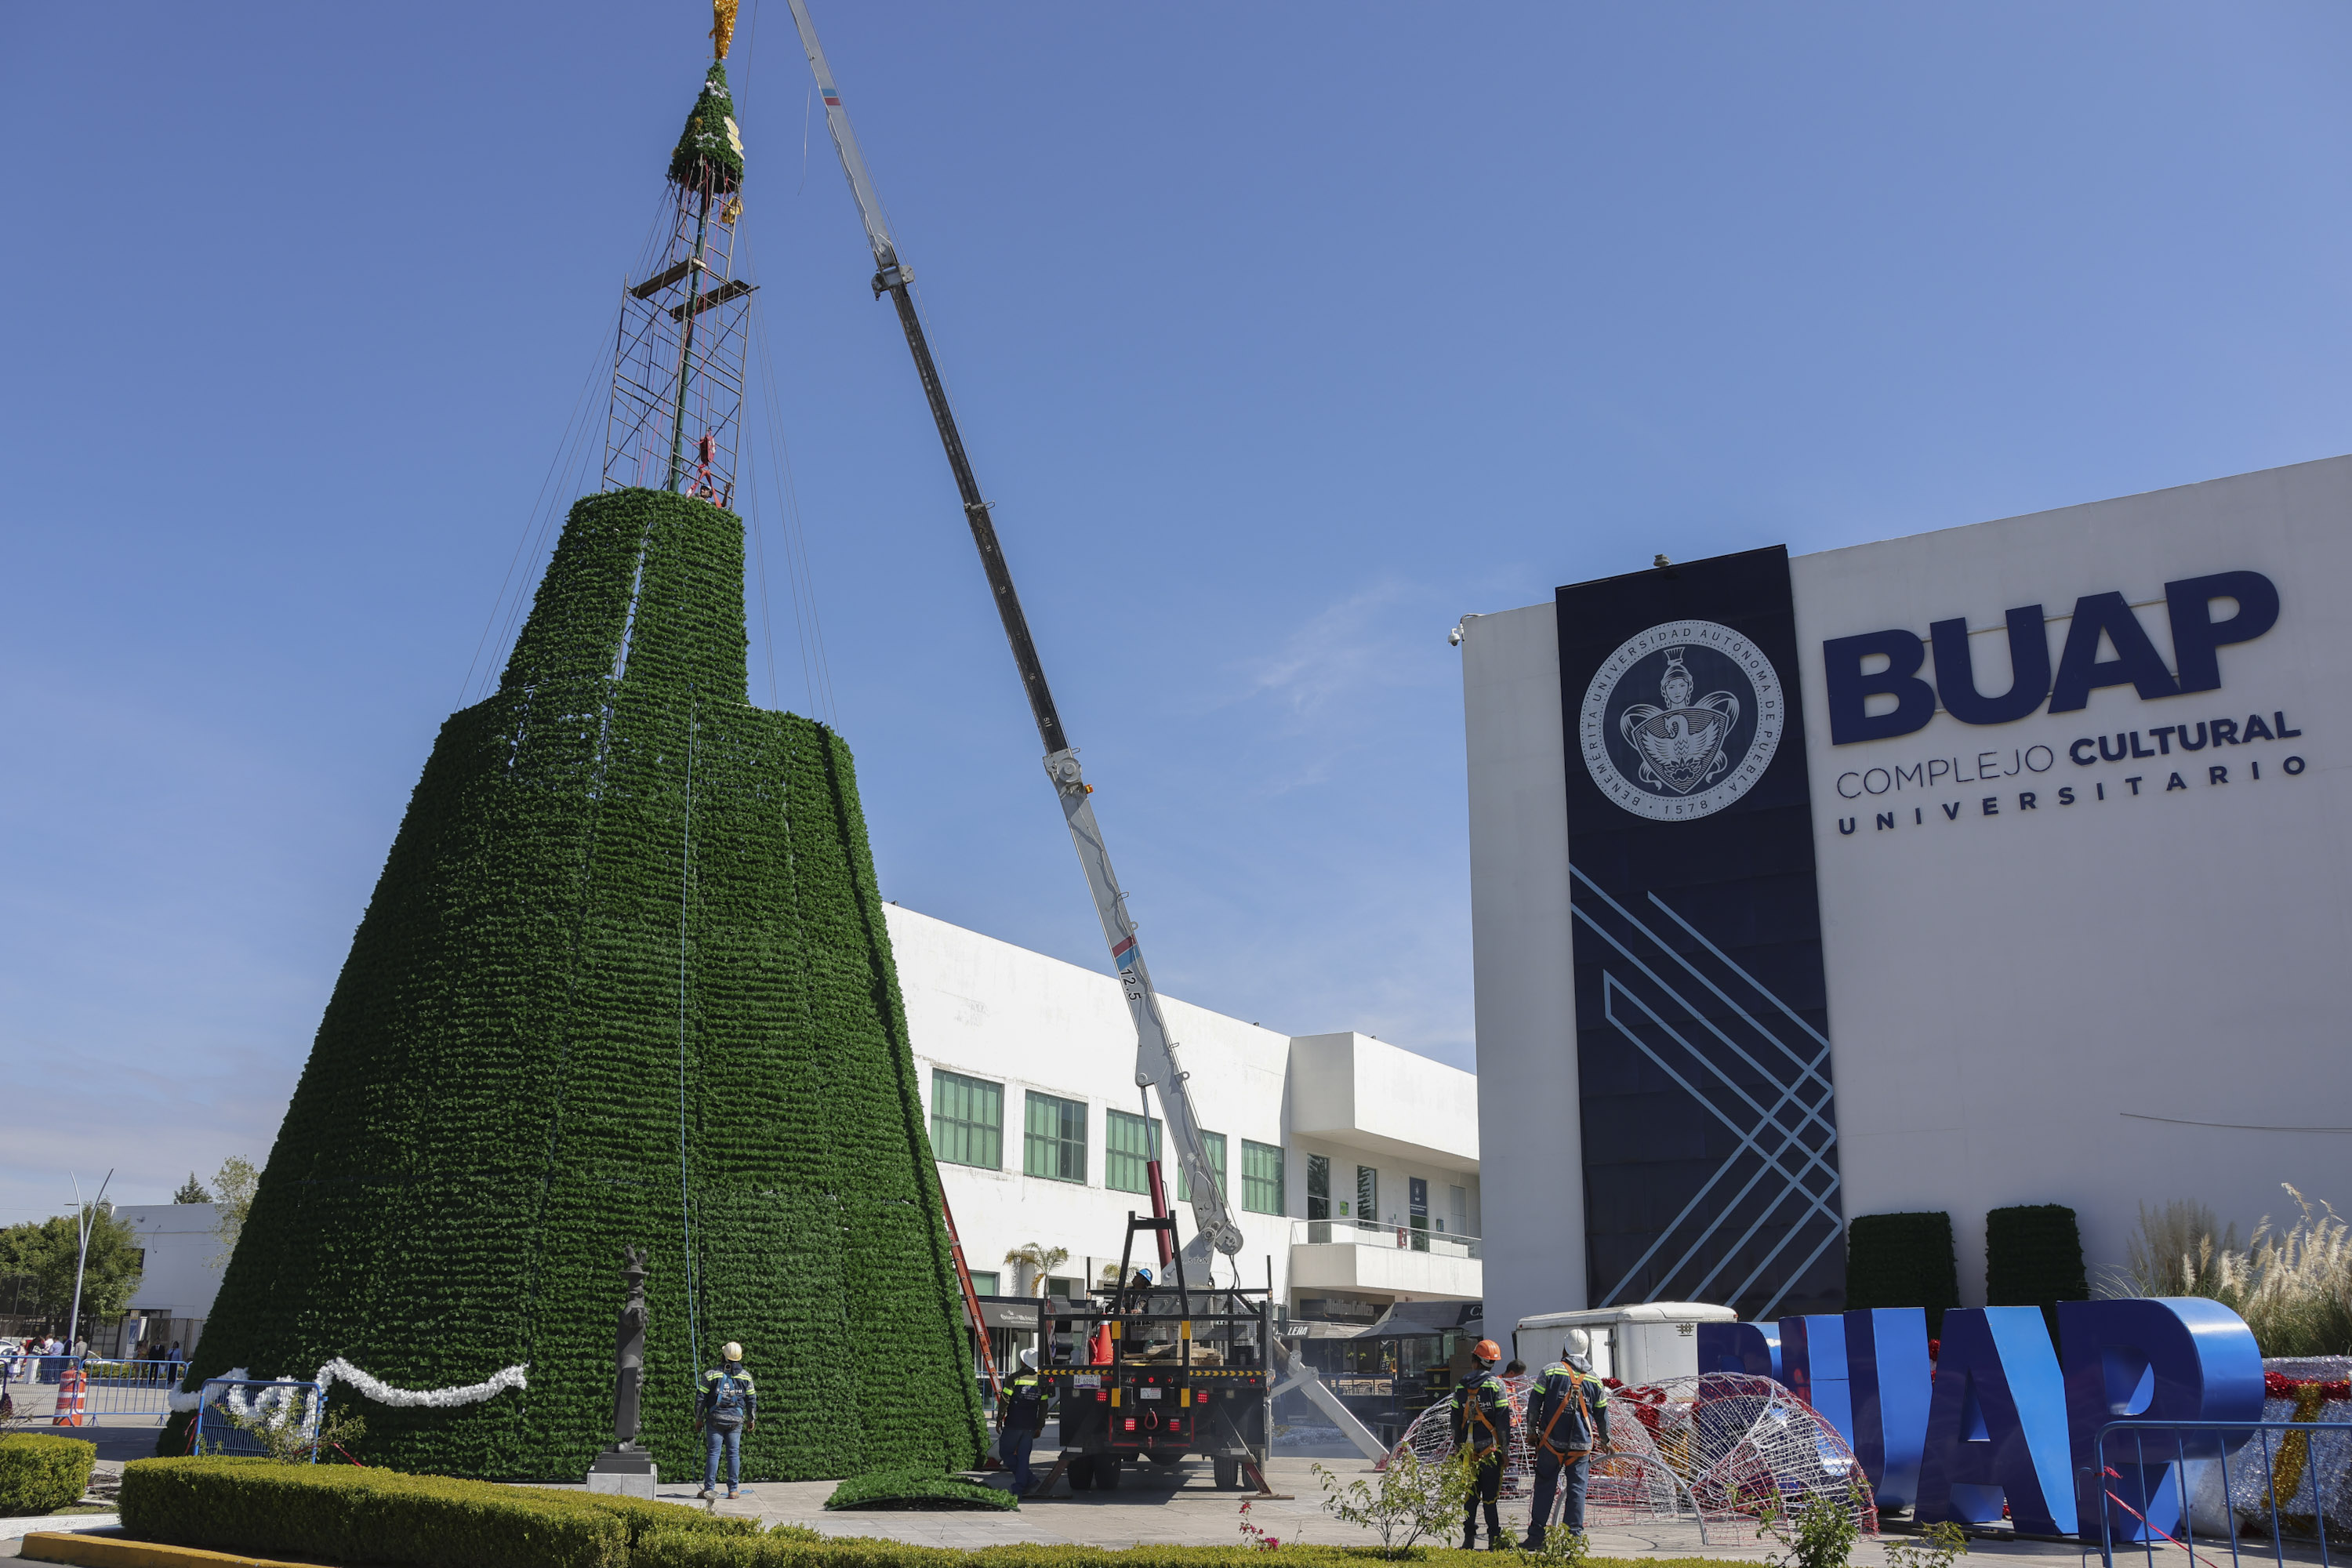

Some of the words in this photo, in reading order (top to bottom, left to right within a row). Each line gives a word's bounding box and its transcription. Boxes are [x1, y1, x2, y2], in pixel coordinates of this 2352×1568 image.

[1592, 628, 1691, 702] UNIVERSIDAD
[1700, 629, 1771, 692] AUTÓNOMA
[1823, 571, 2279, 746] BUAP
[1766, 700, 1775, 721] DE
[1588, 711, 1639, 807] BENEMÉRITA
[1729, 731, 1773, 792] PUEBLA
[1837, 746, 2054, 799] COMPLEJO
[2069, 711, 2301, 766] CULTURAL
[1664, 800, 1708, 815] 1578
[1838, 756, 2305, 835] UNIVERSITARIO
[1120, 967, 1142, 1001] 12.5
